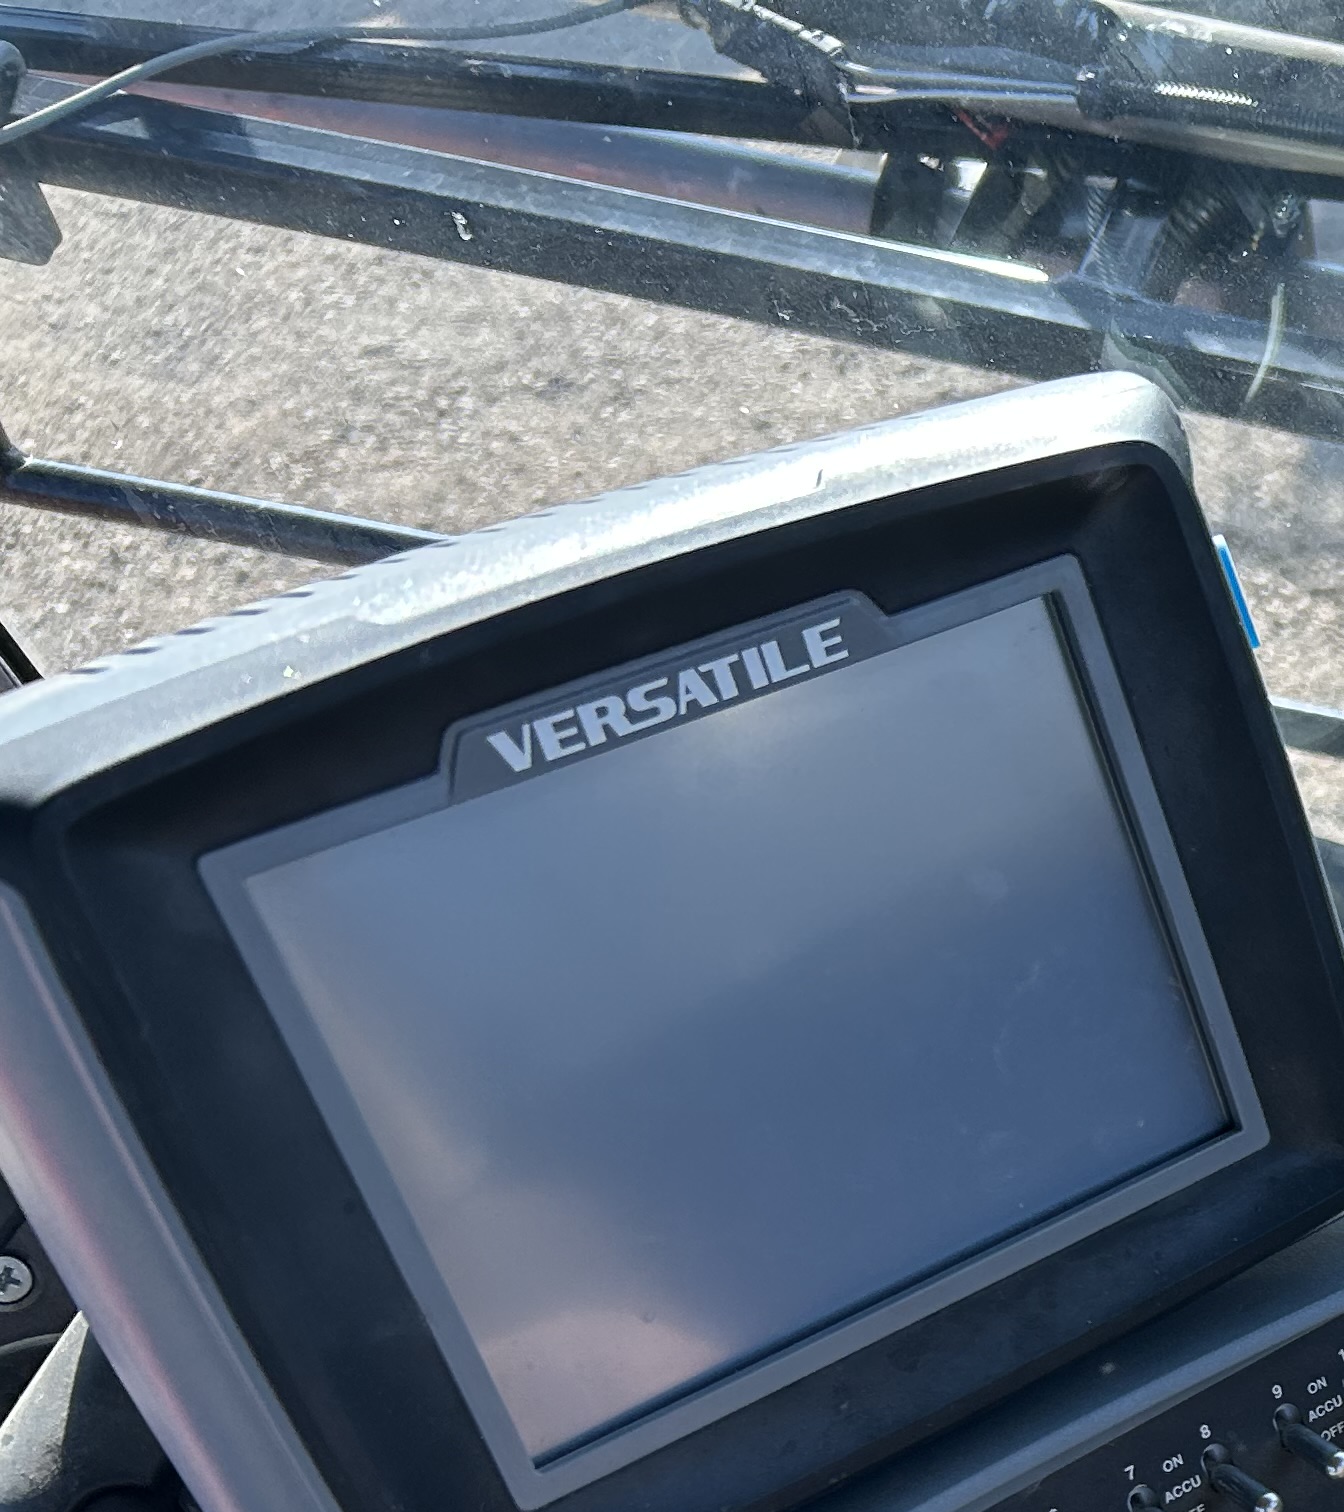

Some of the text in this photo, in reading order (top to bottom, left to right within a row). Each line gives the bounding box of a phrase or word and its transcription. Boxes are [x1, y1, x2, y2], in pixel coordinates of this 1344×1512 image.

[486, 618, 849, 772] VERSATILE
[1272, 1385, 1283, 1399] 9
[1307, 1376, 1328, 1395] ON
[1308, 1394, 1343, 1423] ACCU
[1200, 1424, 1211, 1438] 8
[1124, 1464, 1135, 1480] 7
[1162, 1453, 1184, 1474] ON
[1164, 1475, 1202, 1504] ACCU
